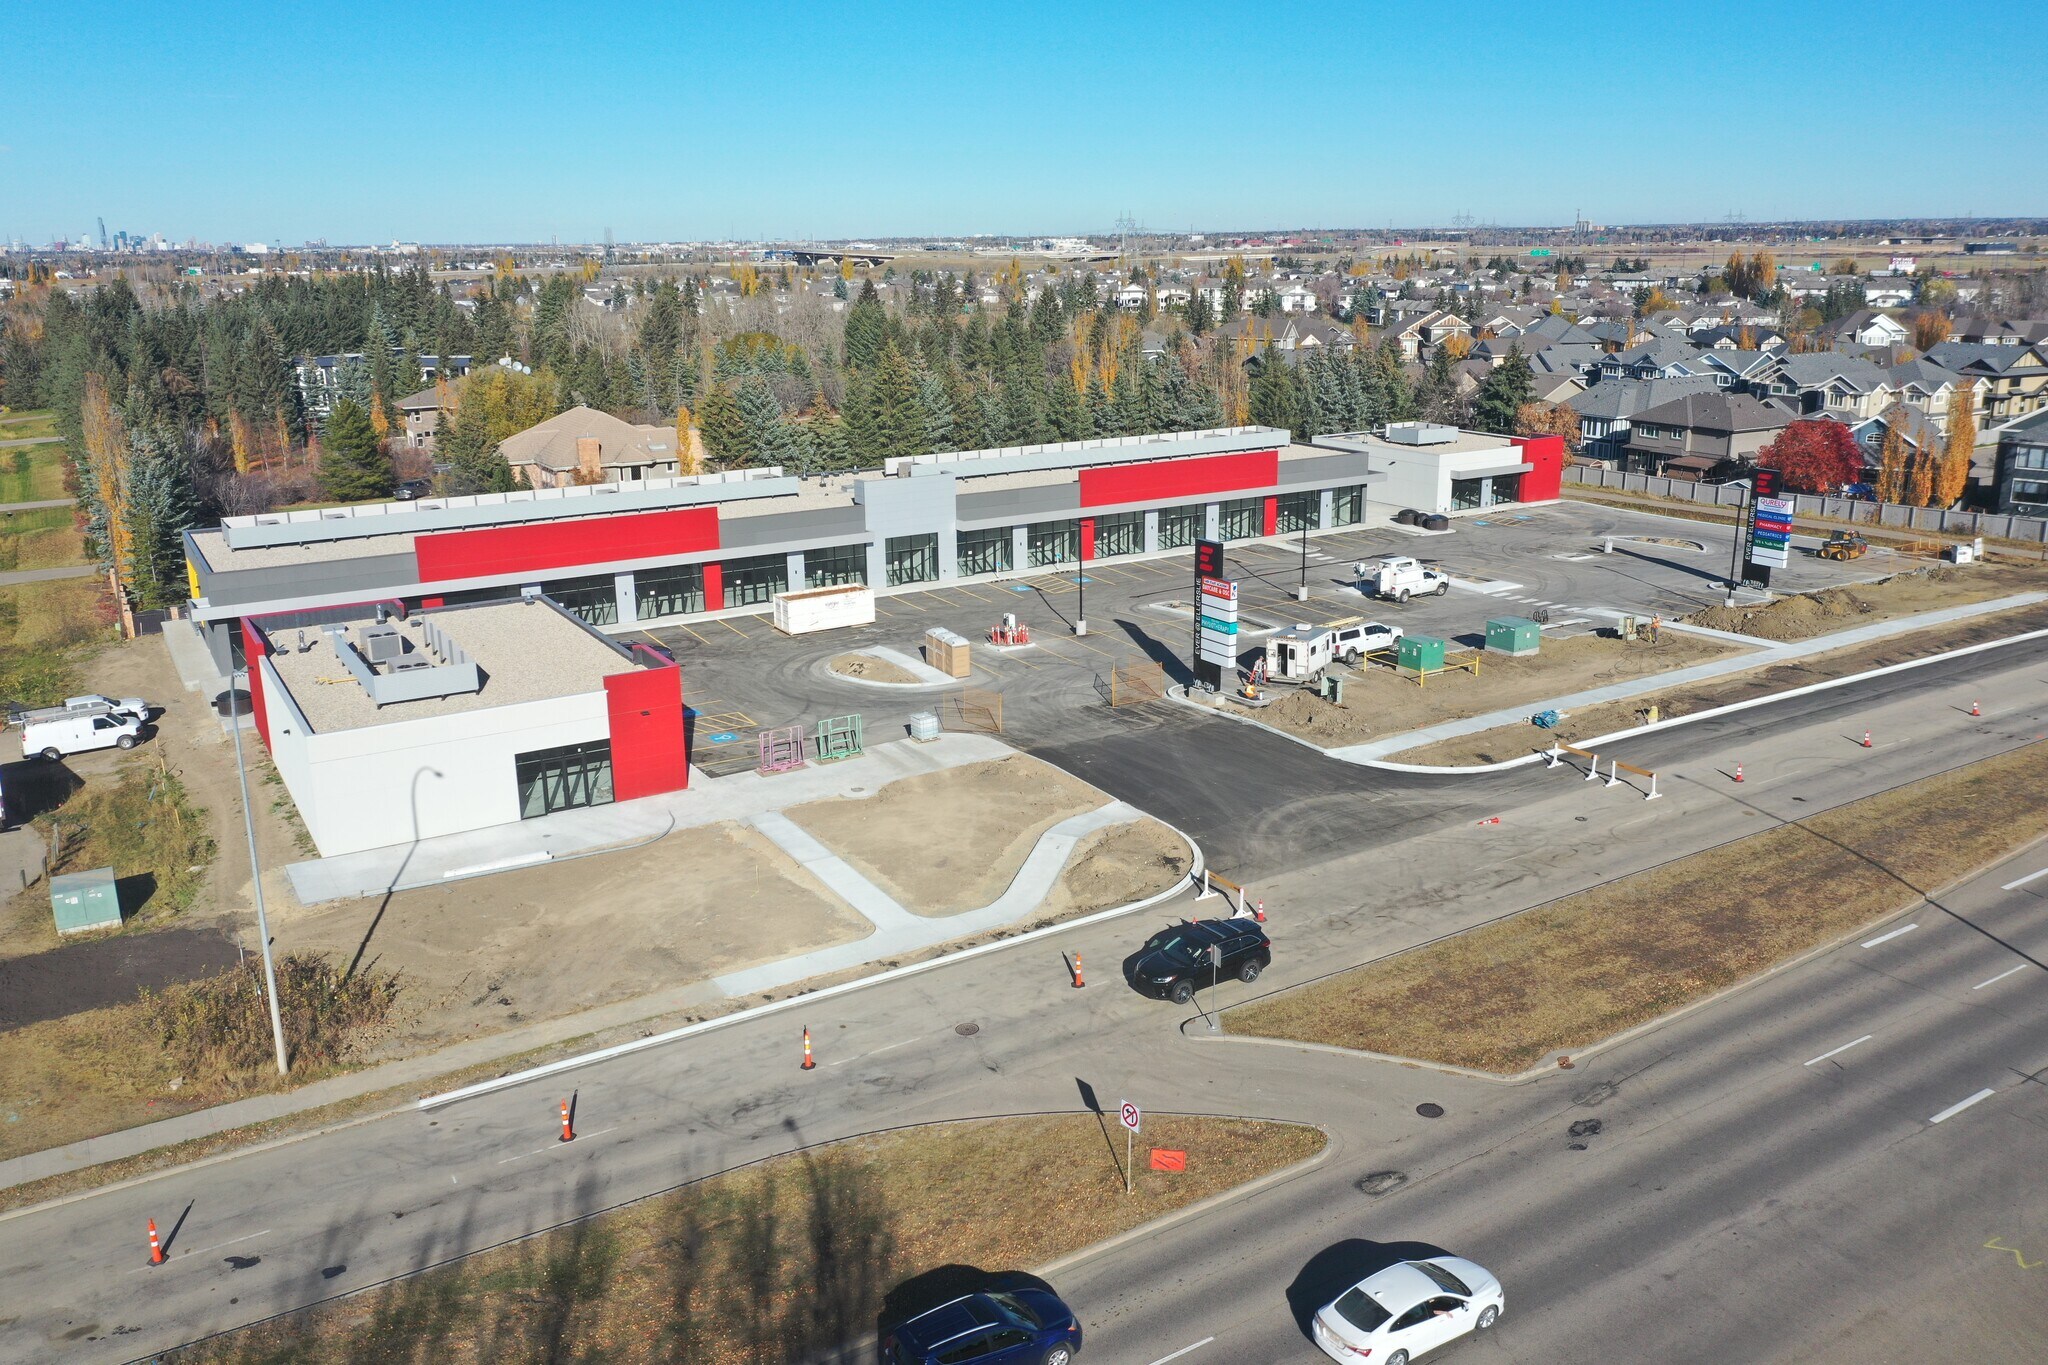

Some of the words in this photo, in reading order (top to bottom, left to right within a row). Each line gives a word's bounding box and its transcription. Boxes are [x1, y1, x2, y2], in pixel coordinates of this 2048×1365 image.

[1748, 498, 1757, 533] ELLERSLIE
[1759, 522, 1782, 530] PHARMACY
[1746, 533, 1753, 541] @
[1757, 531, 1782, 539] PEDIATRICS
[1195, 622, 1200, 631] @
[1201, 620, 1230, 633] PHYSIOTHERAPY
